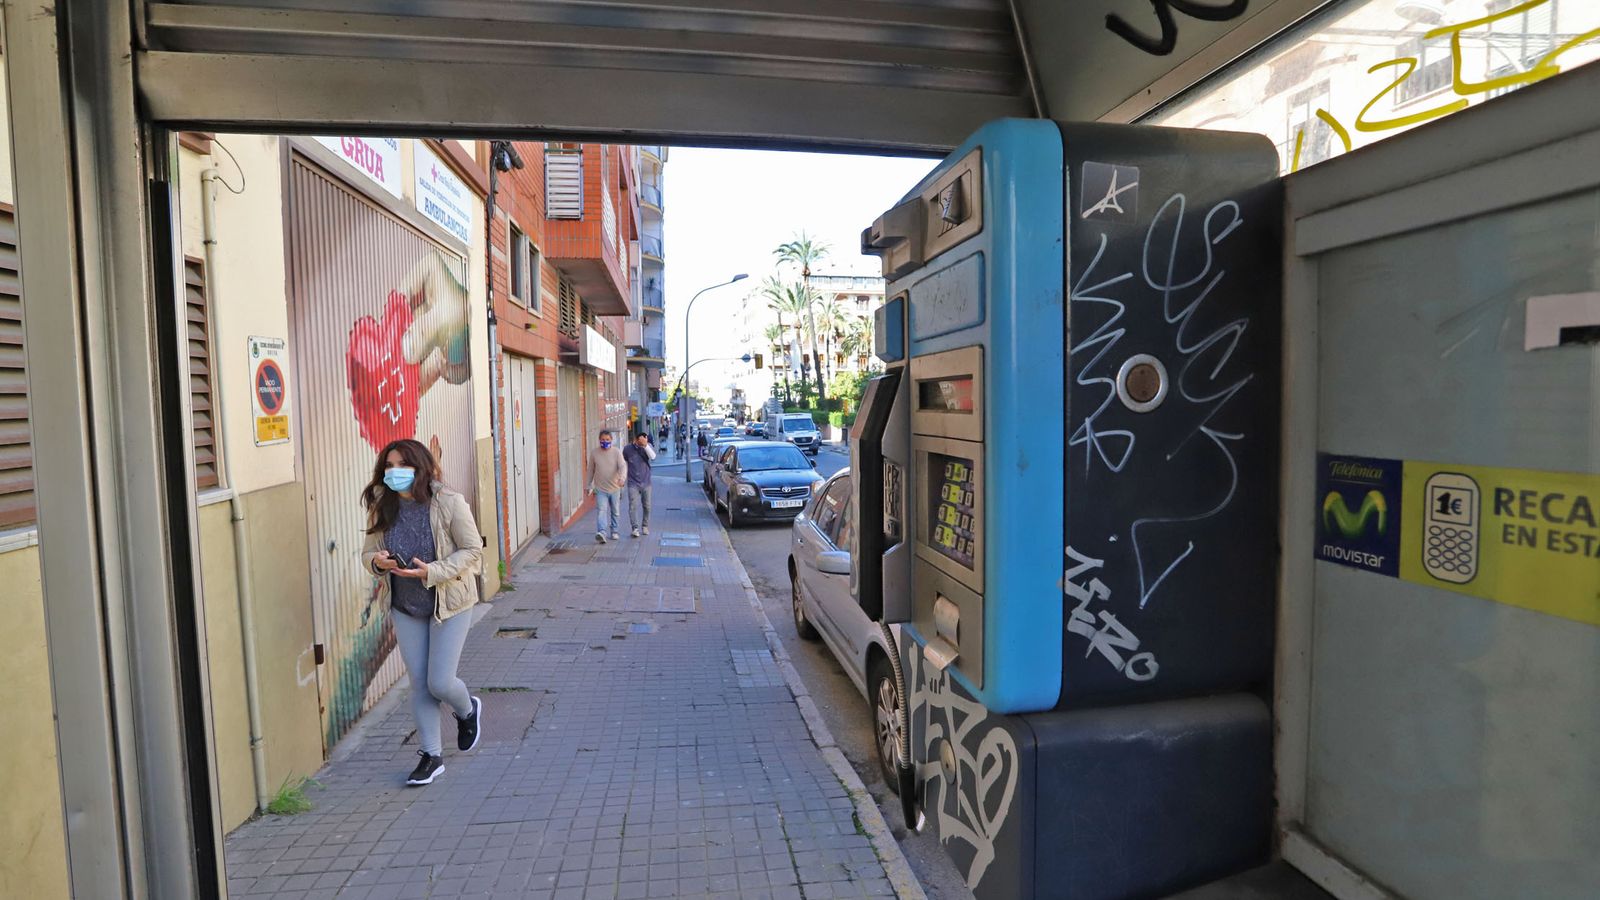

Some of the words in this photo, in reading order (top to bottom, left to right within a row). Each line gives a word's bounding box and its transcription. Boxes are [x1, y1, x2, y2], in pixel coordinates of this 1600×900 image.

[340, 136, 386, 183] GRUA
[424, 197, 468, 243] AMBULANCIAS
[1435, 491, 1463, 516] 1€
[1502, 523, 1537, 549] EN
[1322, 544, 1385, 569] movistar
